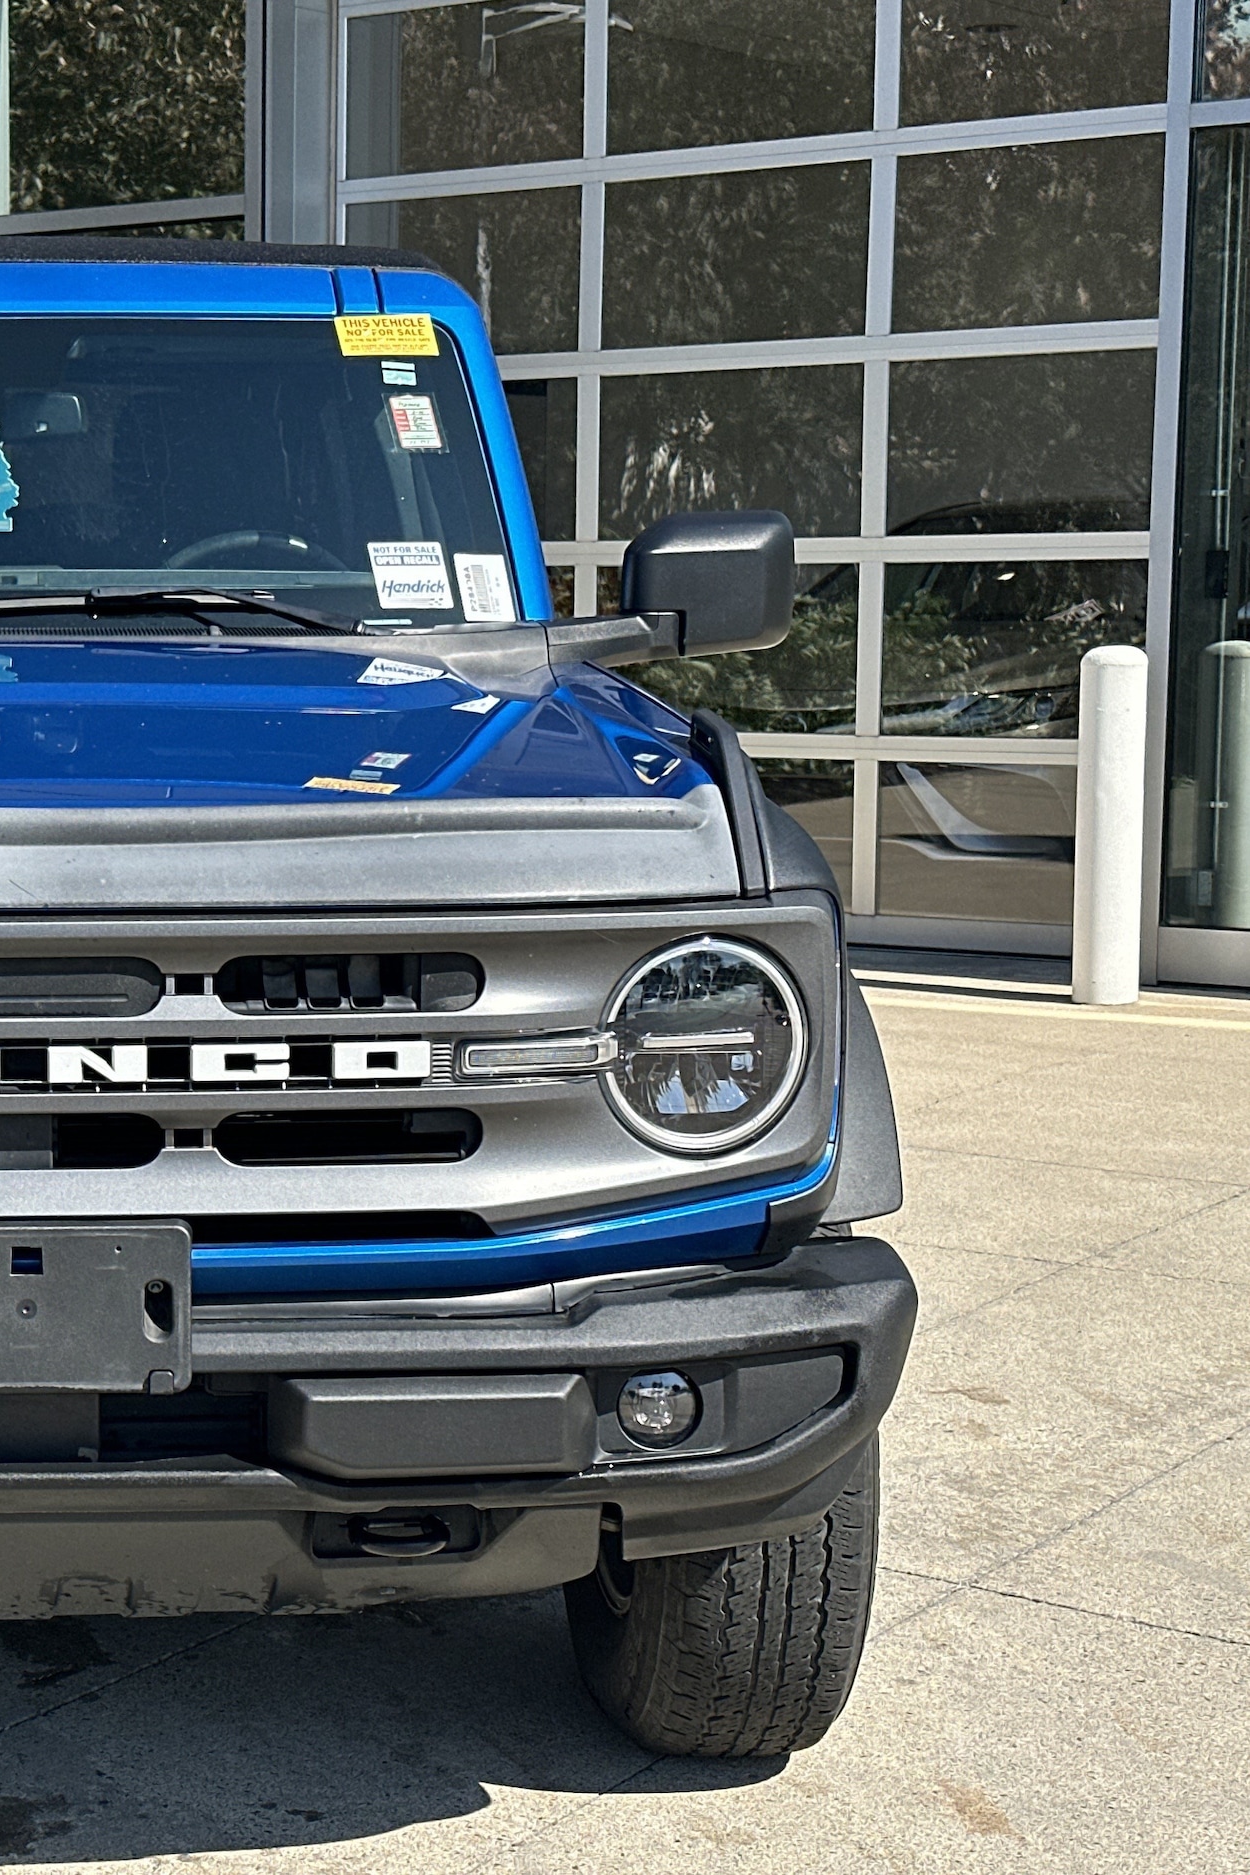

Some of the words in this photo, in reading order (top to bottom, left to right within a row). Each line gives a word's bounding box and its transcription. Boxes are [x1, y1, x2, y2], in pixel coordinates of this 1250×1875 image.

[342, 319, 370, 328] THIS
[372, 317, 426, 328] VEHICLE
[371, 328, 394, 336] FOR
[397, 328, 425, 336] SALE
[372, 546, 390, 554] NOT
[393, 546, 412, 554] FOR
[414, 546, 437, 554] SALE
[375, 556, 402, 565] OPEN
[403, 555, 440, 565] RECALL
[381, 580, 446, 597] Hendrick
